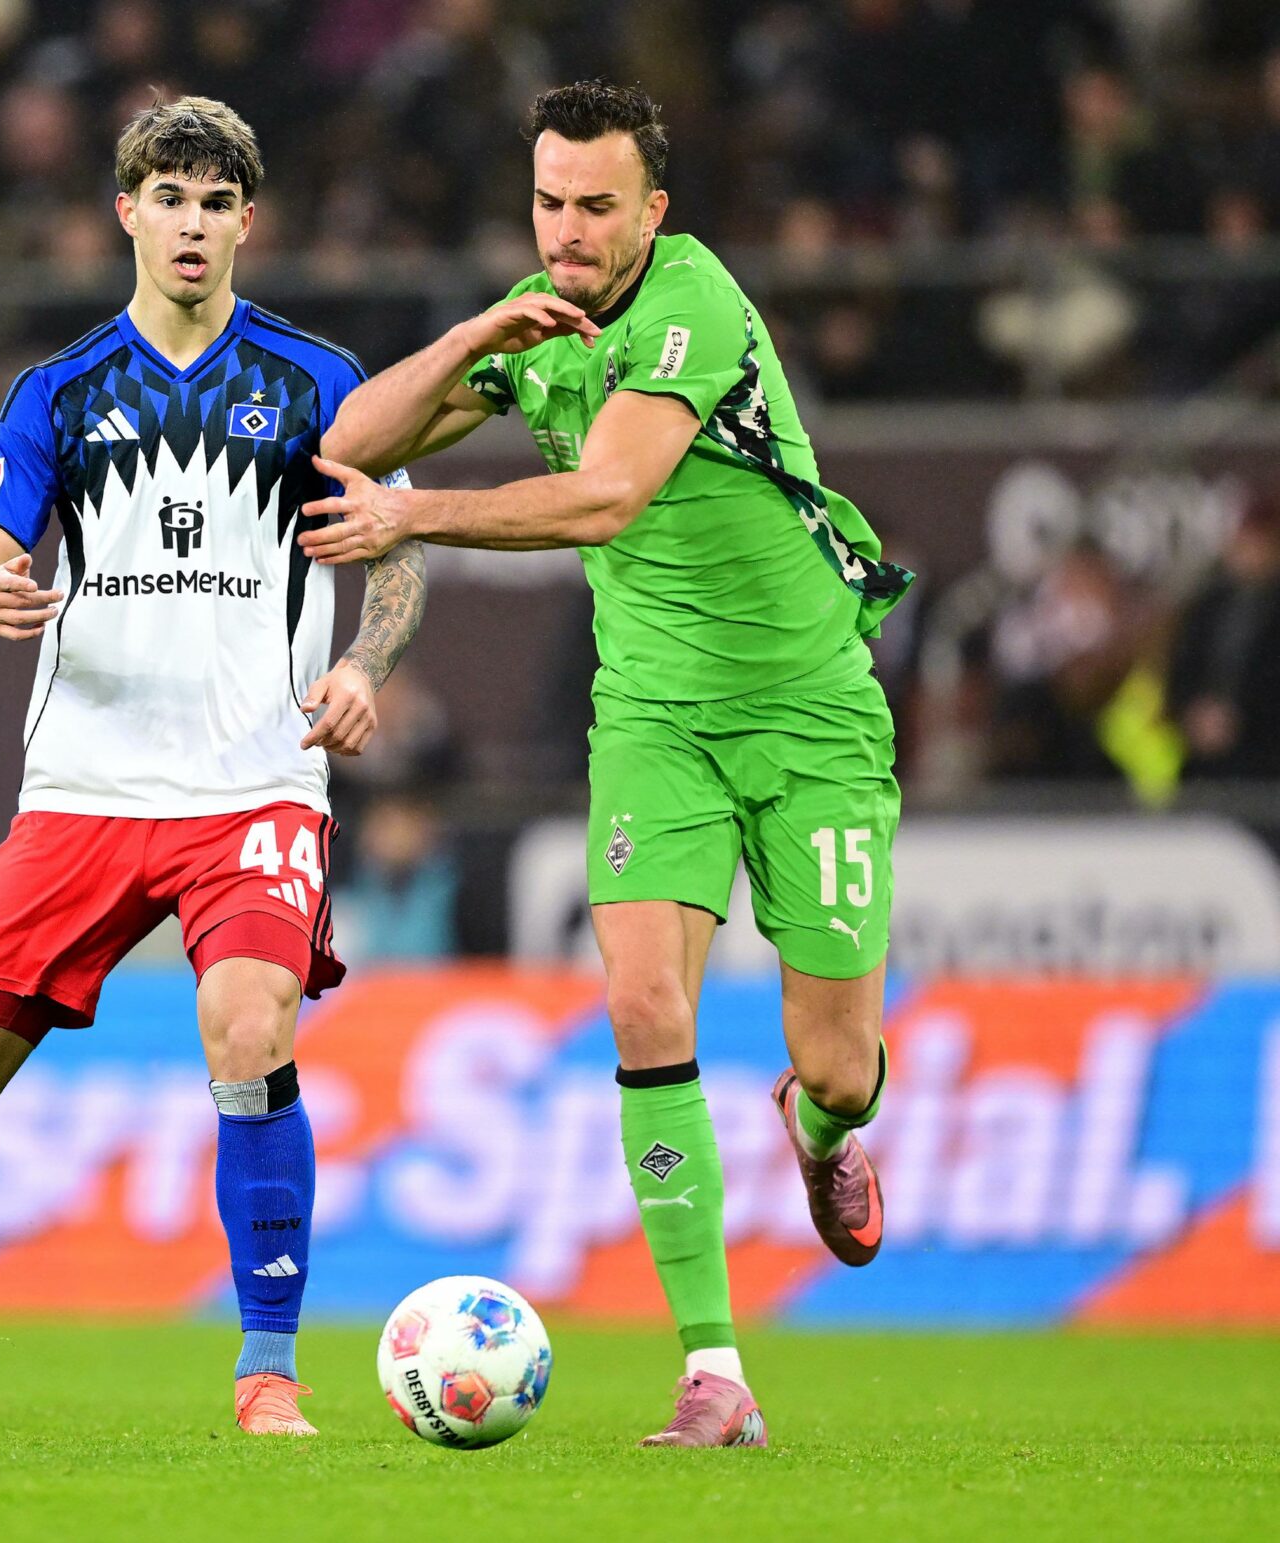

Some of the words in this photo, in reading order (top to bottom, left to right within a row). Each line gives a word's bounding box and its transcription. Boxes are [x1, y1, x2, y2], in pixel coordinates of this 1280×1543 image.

[656, 348, 678, 379] sone
[83, 569, 262, 600] HanseMerkur
[239, 820, 324, 894] 44
[810, 827, 873, 908] 15
[251, 1216, 302, 1231] HSV
